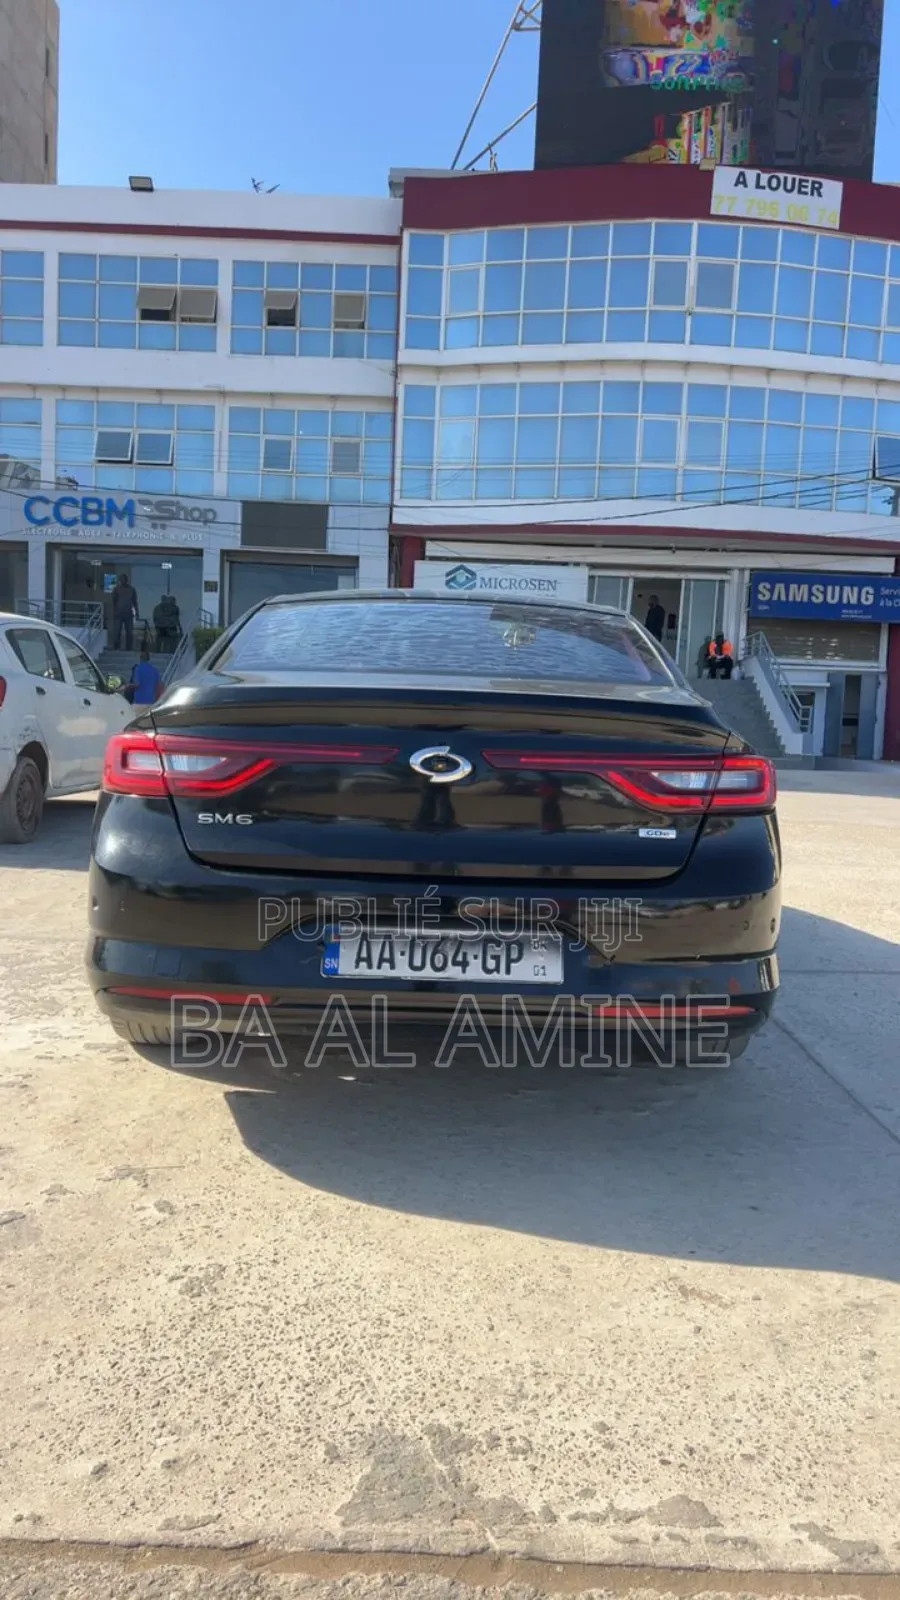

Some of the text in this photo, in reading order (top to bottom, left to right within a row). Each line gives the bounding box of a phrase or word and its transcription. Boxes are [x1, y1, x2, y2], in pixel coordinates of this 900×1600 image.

[733, 171, 823, 197] A LOUER
[24, 496, 136, 528] CCBM
[480, 576, 557, 591] MICROSEN
[758, 582, 874, 605] SAMSUNG
[197, 812, 254, 825] SM6
[324, 957, 339, 970] SN
[533, 964, 547, 977] 01
